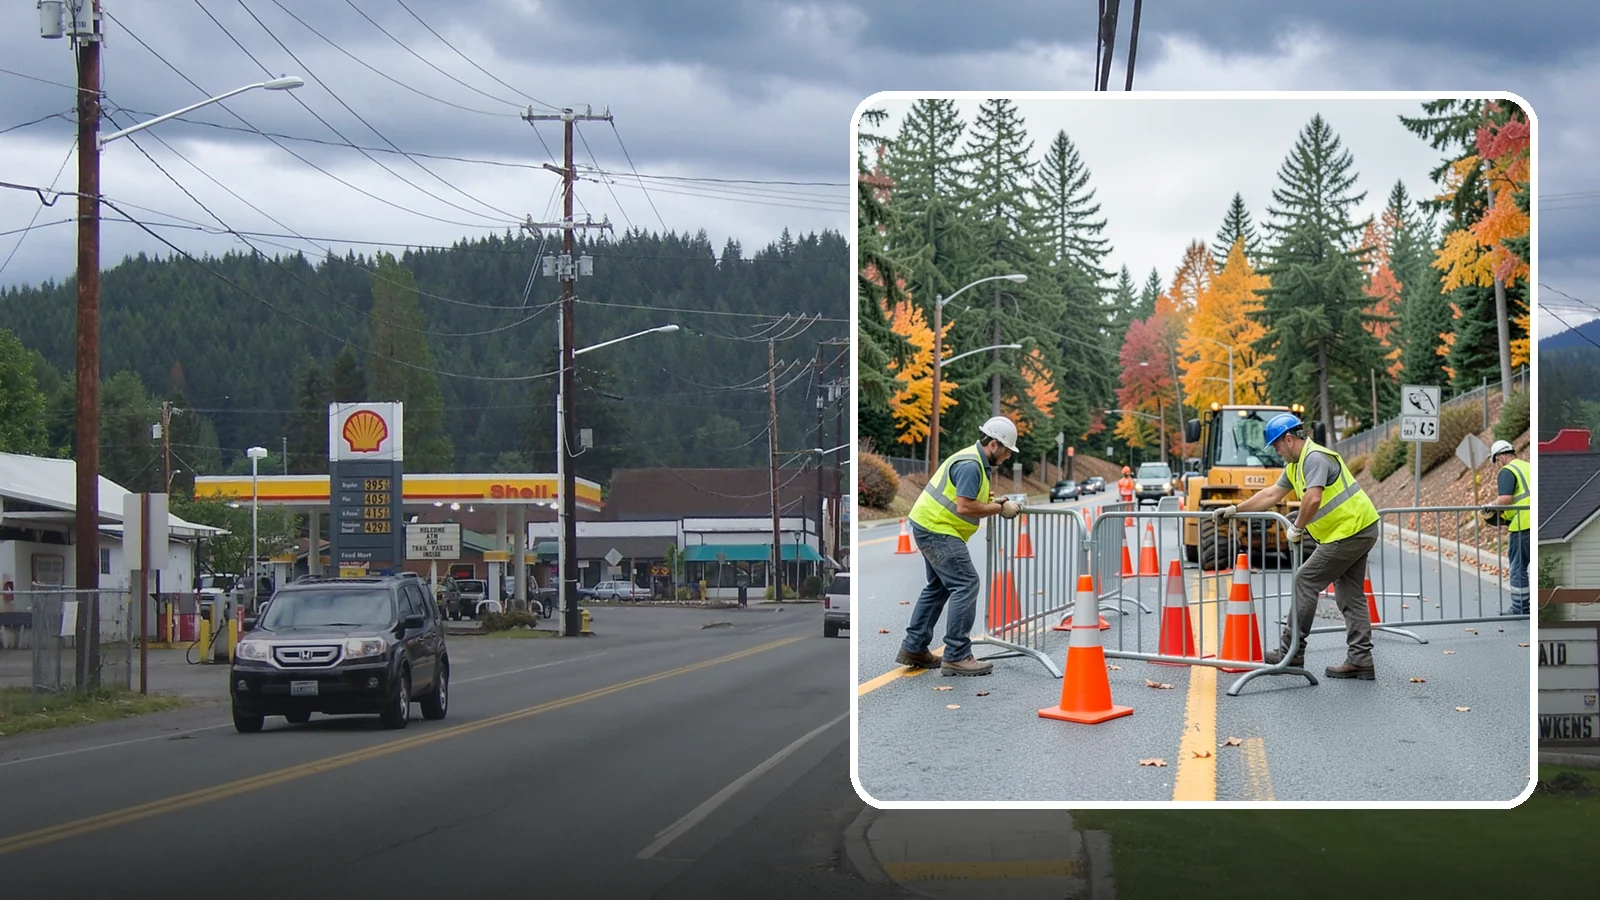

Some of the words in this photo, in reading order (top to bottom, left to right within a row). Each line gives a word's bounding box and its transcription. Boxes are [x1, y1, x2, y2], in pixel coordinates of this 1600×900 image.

[366, 480, 383, 490] 395
[490, 484, 548, 499] Shell
[366, 494, 383, 504] 405
[366, 508, 383, 518] 415
[366, 522, 383, 532] 429
[1539, 643, 1567, 665] AID
[1539, 716, 1592, 739] WKENS
